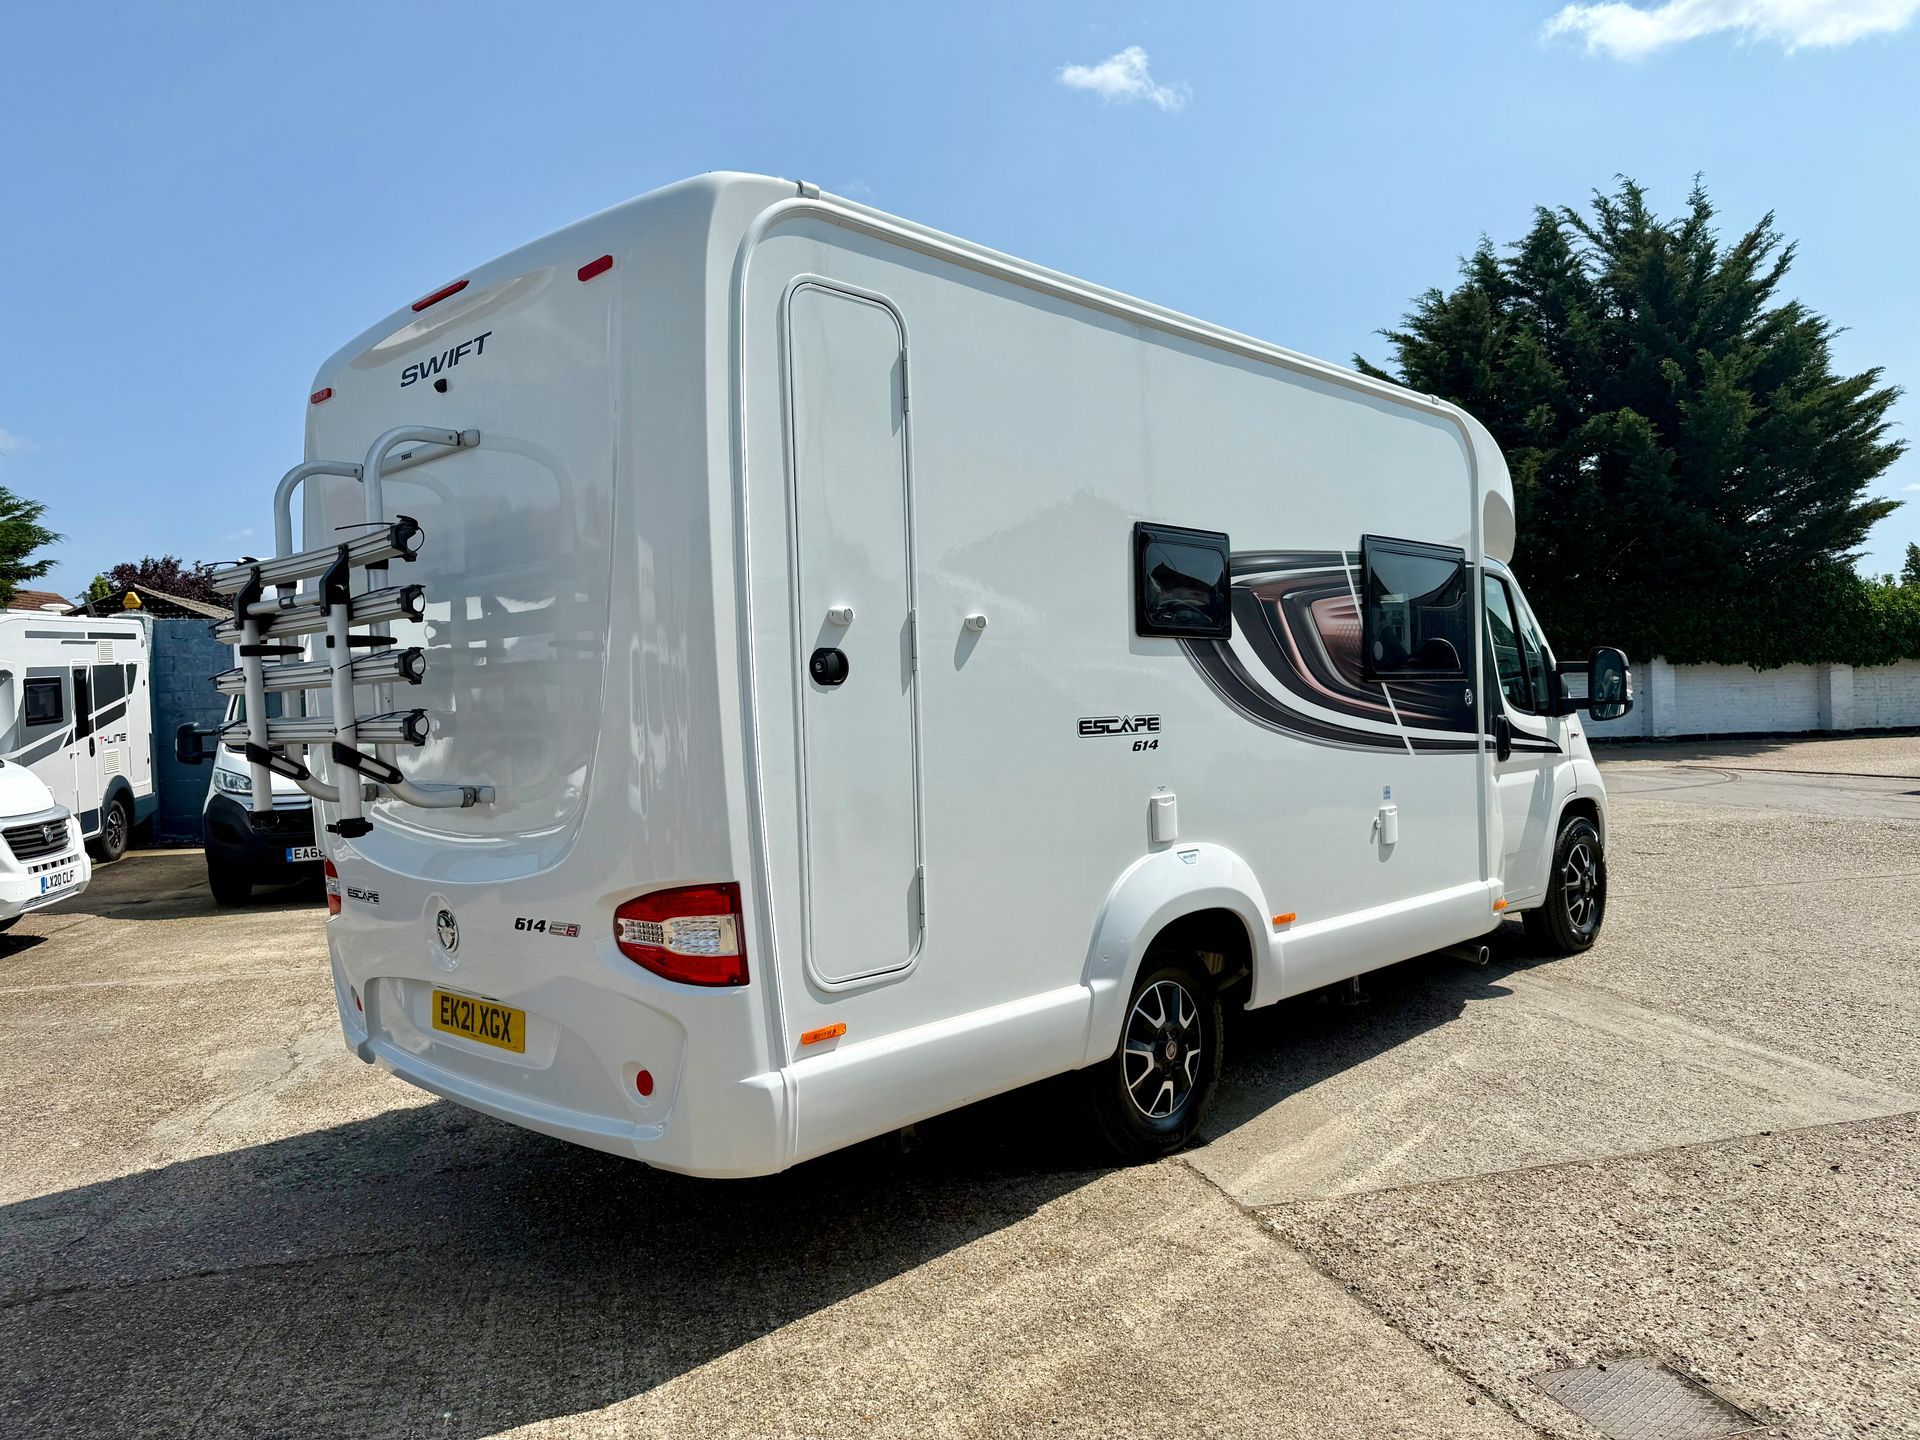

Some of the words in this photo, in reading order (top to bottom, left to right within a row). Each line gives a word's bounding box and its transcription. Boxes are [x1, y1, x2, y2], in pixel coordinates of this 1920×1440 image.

[400, 331, 492, 388] SWIFT
[1080, 717, 1160, 735] ESCAPE
[1132, 739, 1159, 752] 614
[46, 873, 62, 889] LX20
[63, 869, 74, 884] CLF
[347, 887, 380, 903] ESCAPE
[514, 917, 547, 933] 614
[441, 995, 475, 1033] EK21
[479, 1005, 512, 1043] XGX
